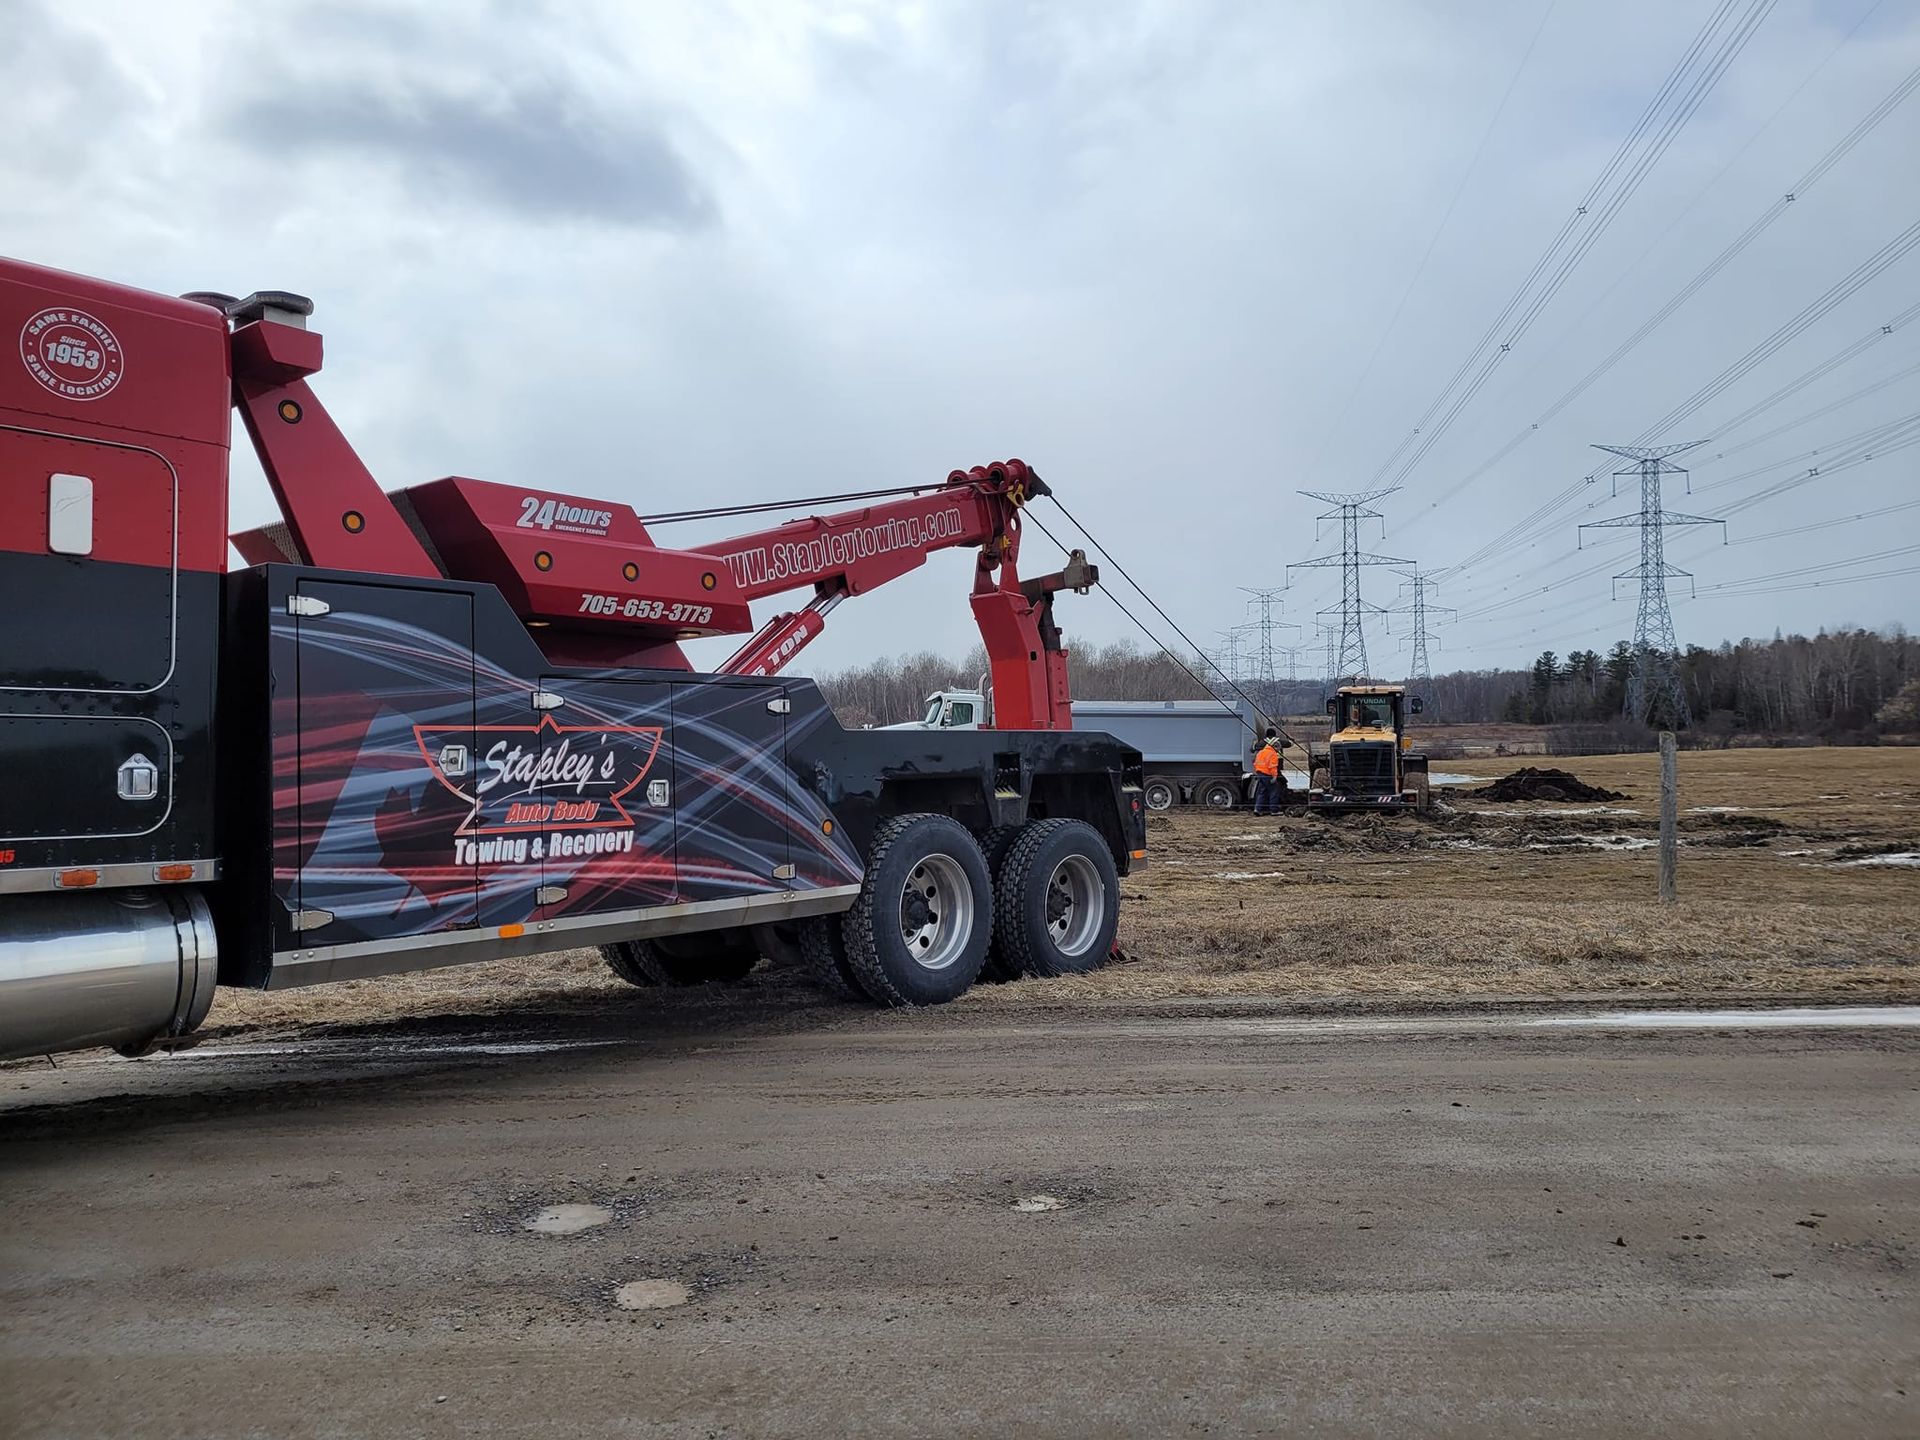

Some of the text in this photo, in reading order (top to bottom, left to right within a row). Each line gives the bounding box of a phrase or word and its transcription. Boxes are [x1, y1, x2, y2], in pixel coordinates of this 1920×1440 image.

[28, 313, 118, 353] SAME FAMILY
[59, 335, 88, 347] Since
[46, 342, 100, 370] 1953
[26, 354, 117, 395] SAME LOCATION
[516, 496, 613, 530] 24 hours
[555, 524, 586, 534] EMERGENCY
[578, 594, 713, 624] 705-653-3773
[767, 624, 809, 666] TON
[476, 733, 616, 795] Stapley's
[505, 800, 600, 823] Auto Body
[454, 830, 635, 865] Towing & Recovery
